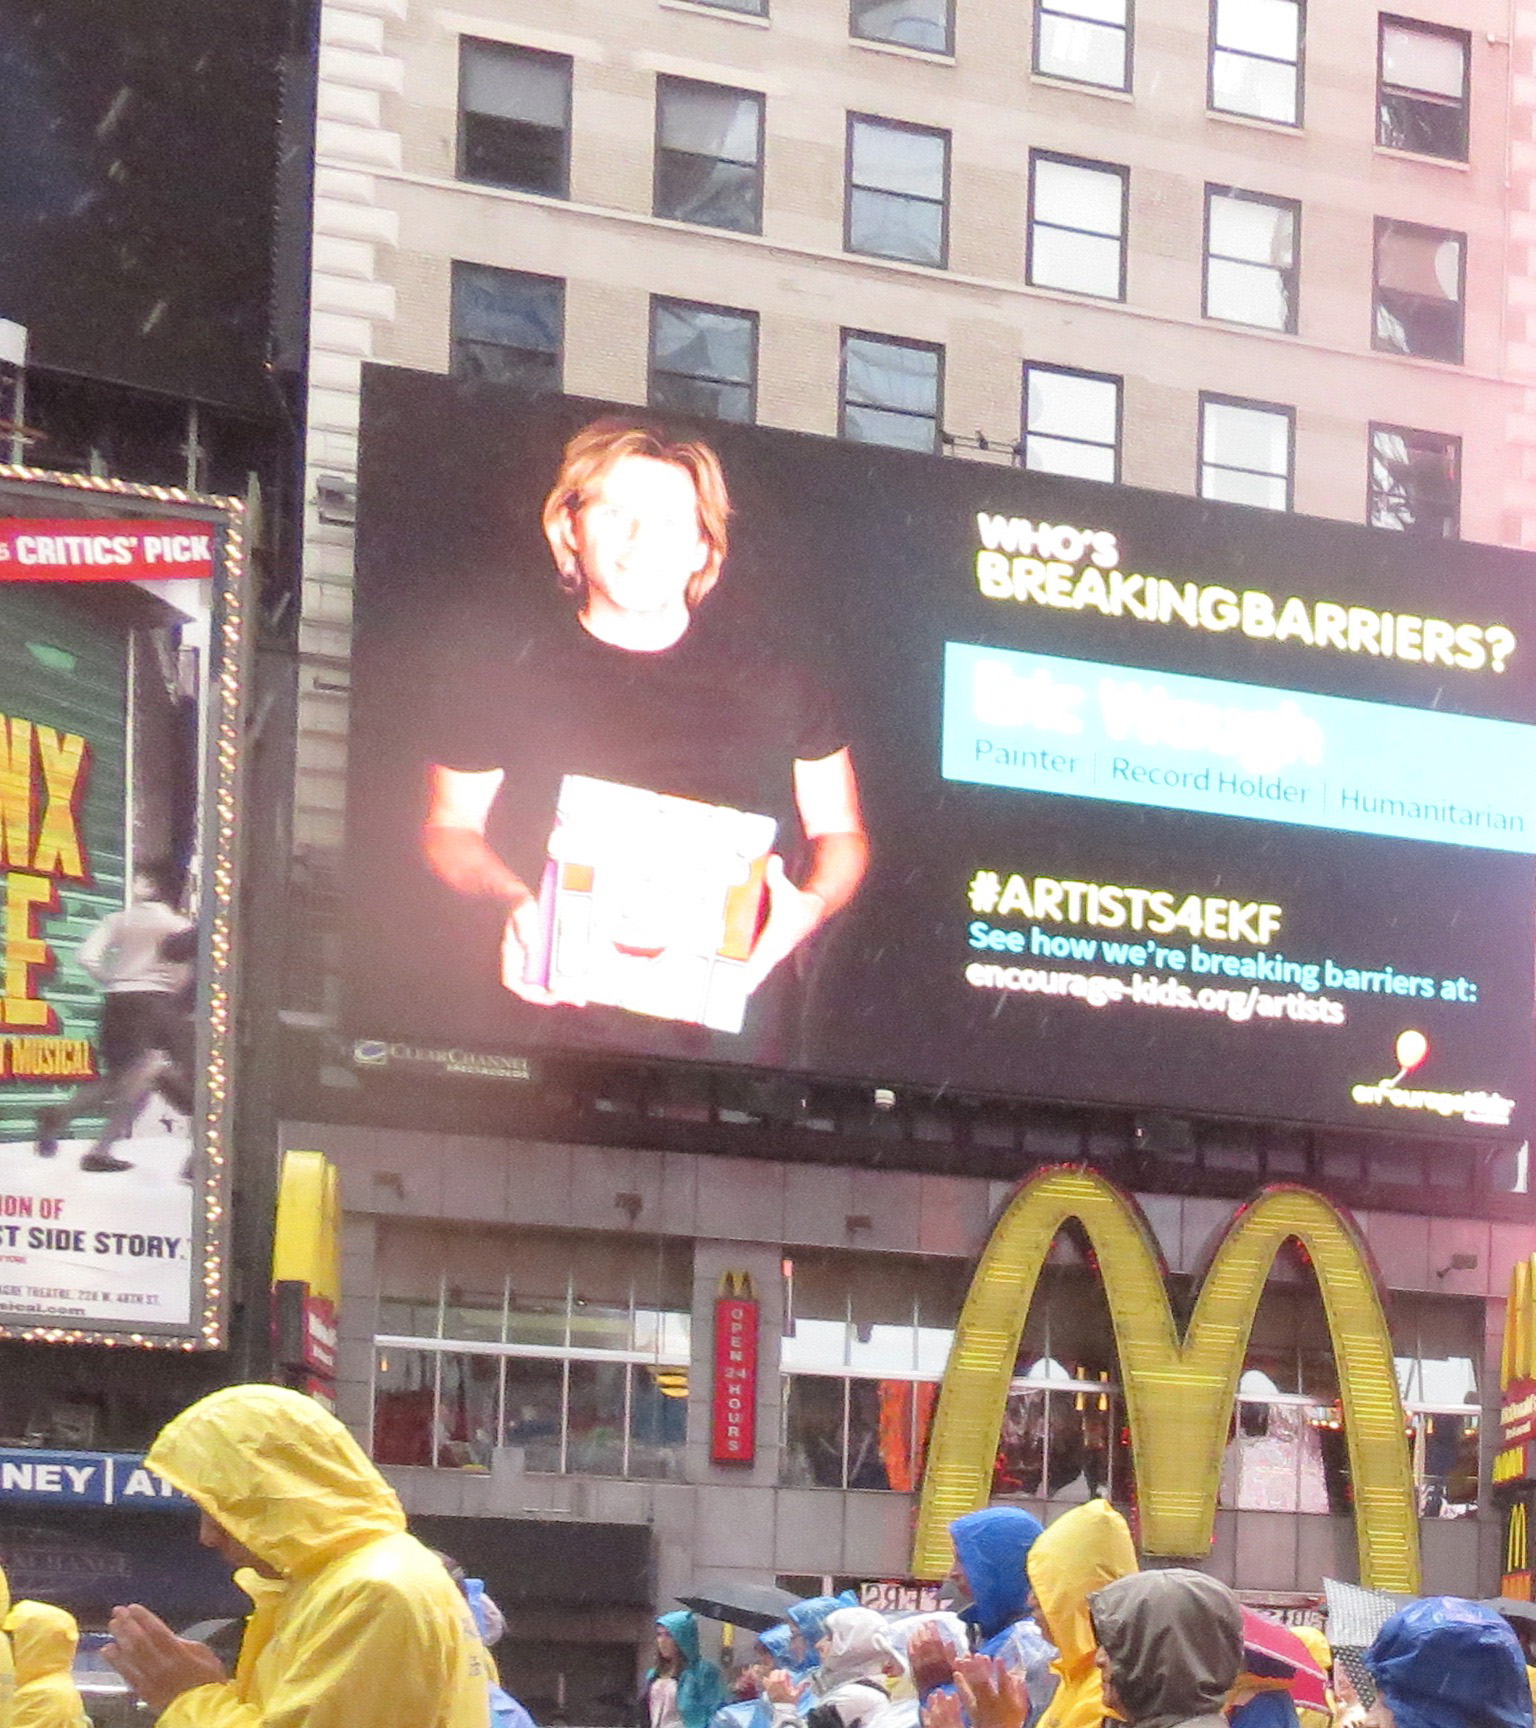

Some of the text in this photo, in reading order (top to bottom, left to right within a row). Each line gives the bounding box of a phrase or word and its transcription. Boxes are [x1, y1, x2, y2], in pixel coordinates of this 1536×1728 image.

[16, 535, 137, 565] CRITICS'
[143, 535, 212, 563] PICK
[977, 511, 1119, 568] WHO'S
[975, 739, 1526, 834] Painter Record Holder Humanitarian
[968, 870, 1282, 943] #ARTISTS4EKF
[968, 921, 1479, 1002] See how we're breaking barriers at:
[28, 1226, 86, 1252] SIDE
[40, 1198, 64, 1220] OF
[725, 1308, 747, 1451] OPEN 24 HOURS
